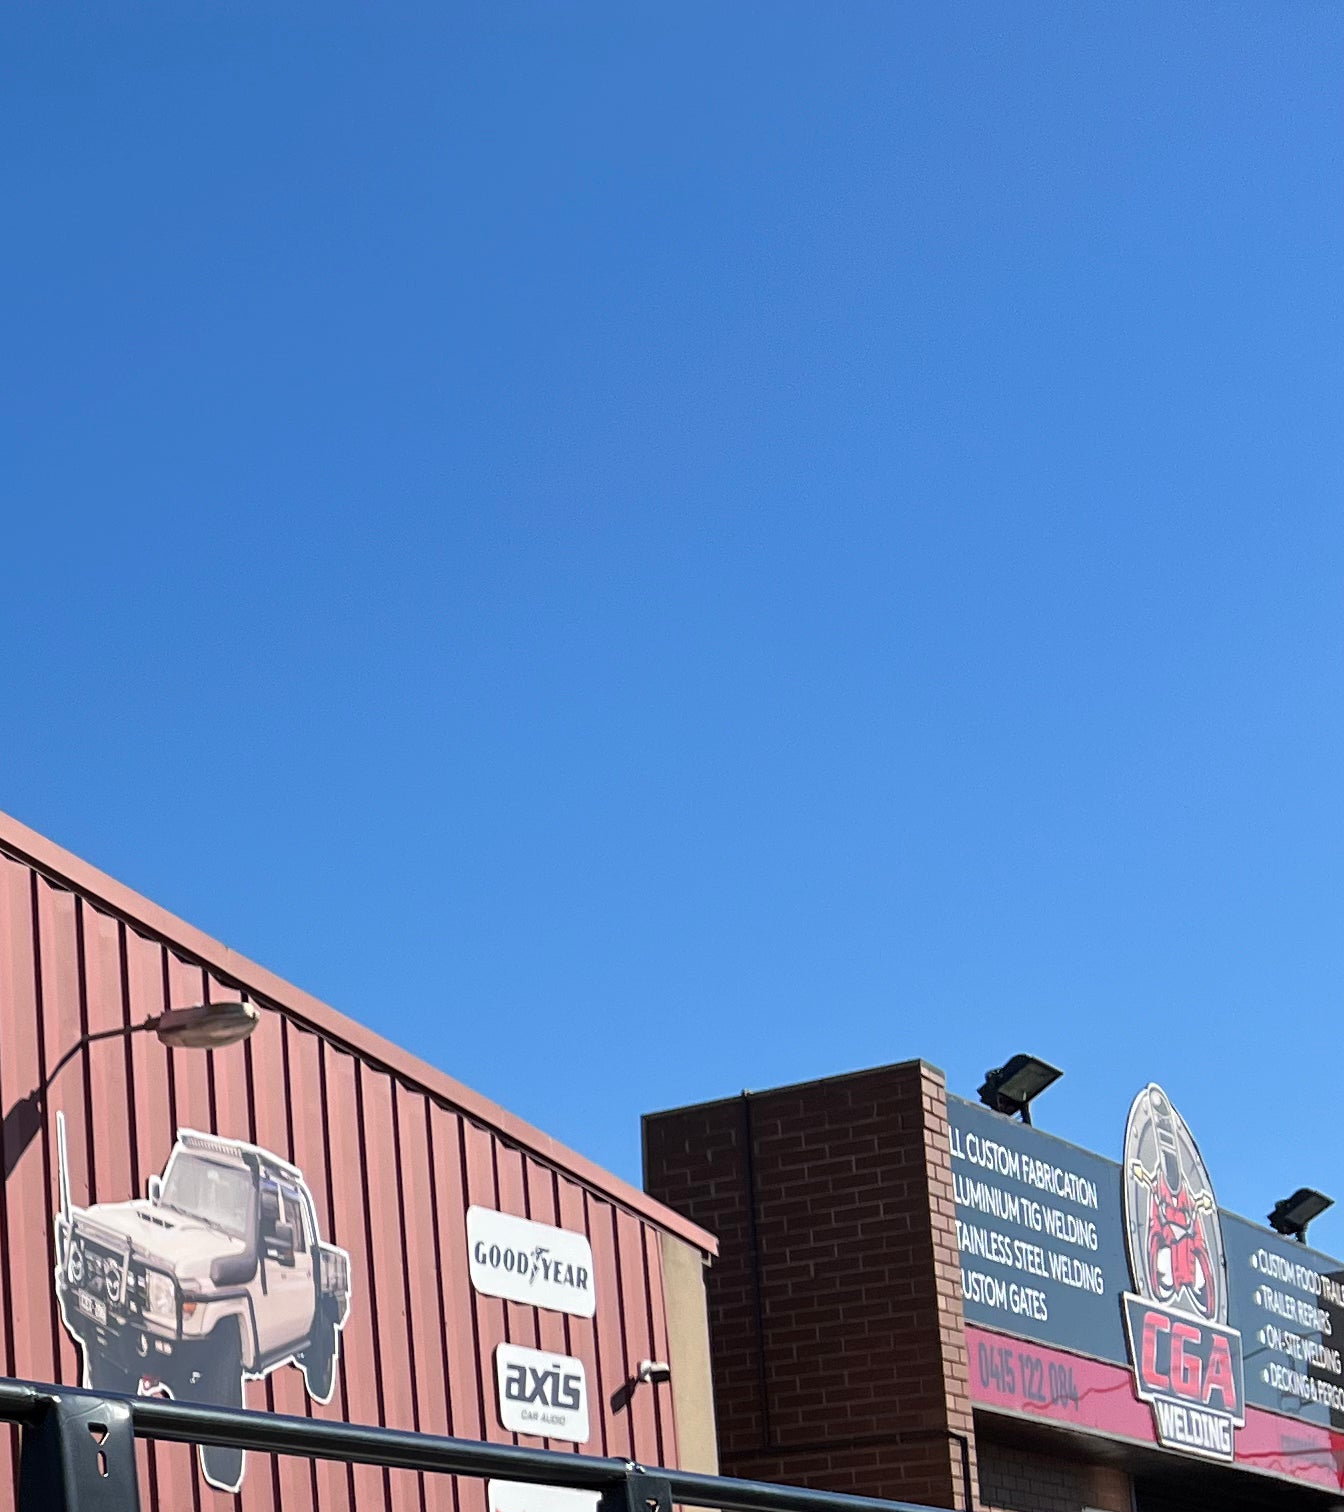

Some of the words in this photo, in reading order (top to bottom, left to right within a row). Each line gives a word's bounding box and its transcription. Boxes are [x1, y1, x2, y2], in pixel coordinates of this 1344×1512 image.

[948, 1125, 965, 1160] LL
[966, 1132, 1021, 1180] CUSTOM
[1021, 1154, 1098, 1210] FABRICATION
[952, 1172, 1020, 1225] LUMINIUM
[1020, 1197, 1042, 1232] TIG
[1042, 1204, 1098, 1251] WELDING
[474, 1240, 588, 1289] GOODYEAR
[954, 1220, 1013, 1267] TAINLESS
[1014, 1240, 1049, 1278] STEEL
[1049, 1251, 1104, 1295] WELDING
[1258, 1248, 1296, 1286] CUSTOM
[1295, 1264, 1322, 1296] FOOD
[961, 1268, 1008, 1311] USTOM
[1009, 1282, 1048, 1321] GATES
[1261, 1284, 1298, 1322] TRAILER
[1297, 1300, 1332, 1336] REPAIRS
[978, 1342, 1015, 1395] 0415
[1018, 1353, 1046, 1403] 122
[1142, 1311, 1237, 1411] CGA
[1267, 1324, 1303, 1360] ON-SITE
[1301, 1339, 1342, 1375] WELDING
[505, 1363, 582, 1411] axis
[1270, 1362, 1310, 1401] DECKING
[521, 1409, 539, 1421] CAR
[540, 1412, 566, 1426] AUDIO
[1157, 1400, 1231, 1452] WELDING
